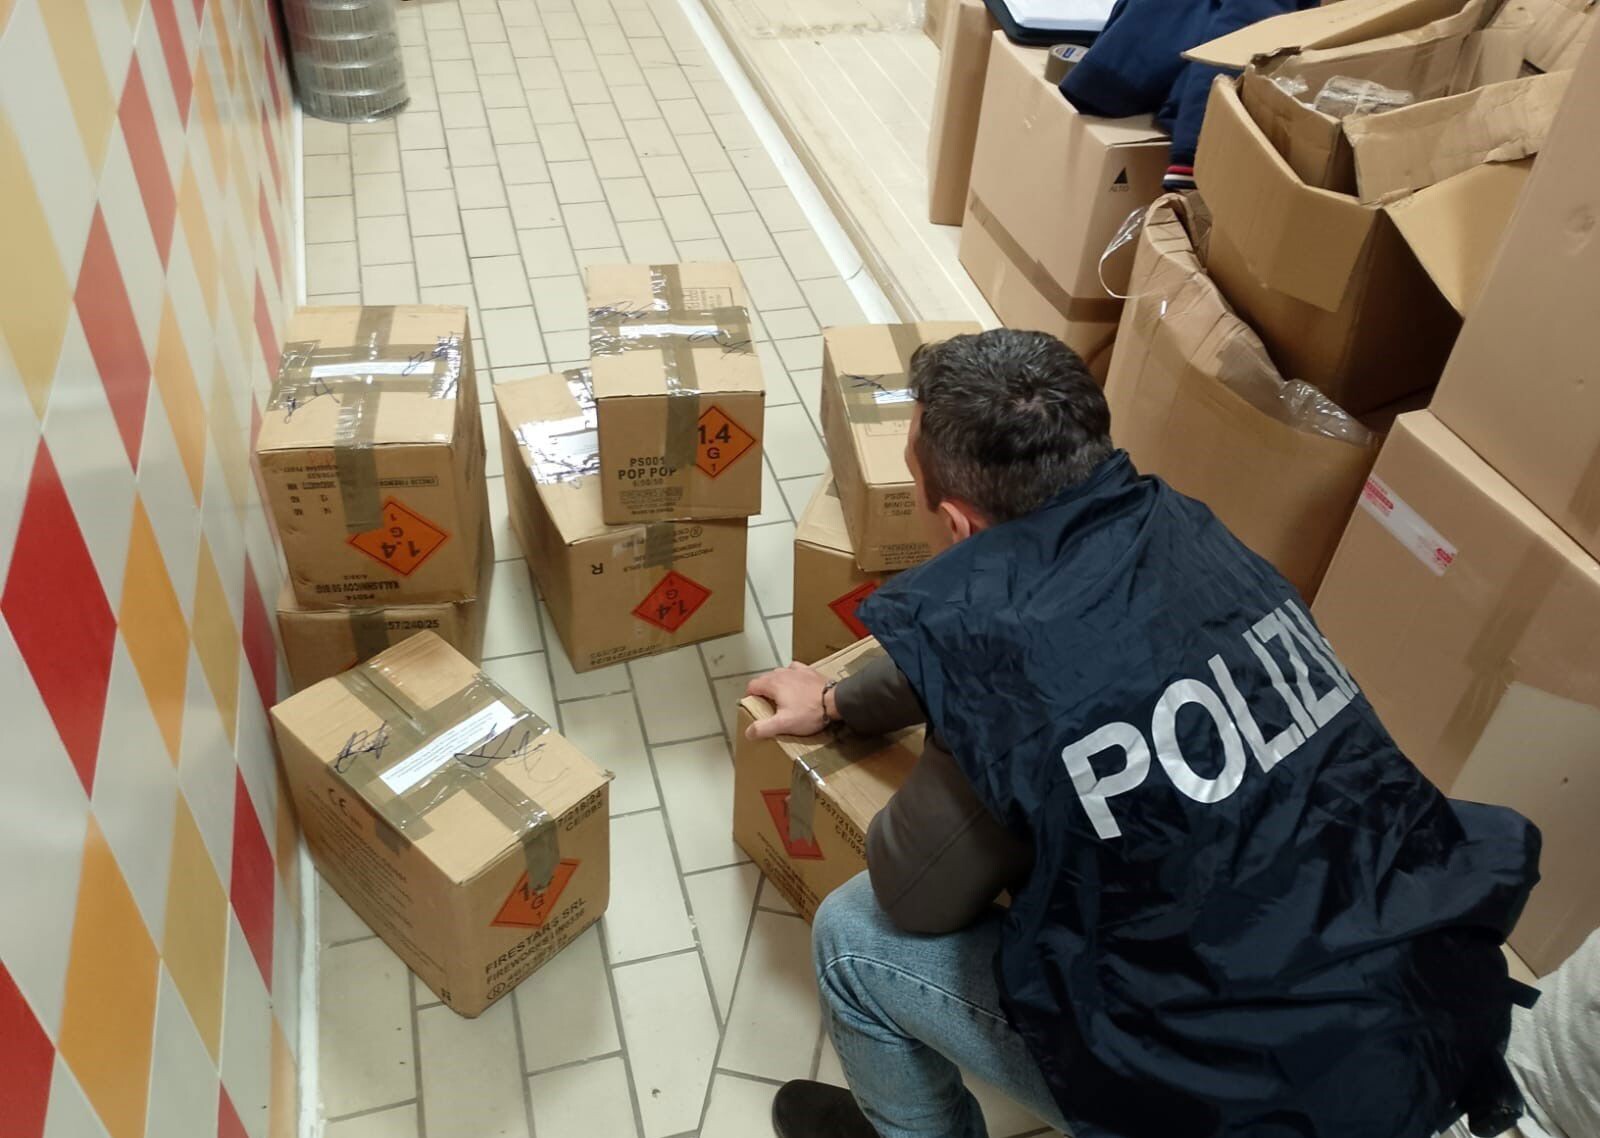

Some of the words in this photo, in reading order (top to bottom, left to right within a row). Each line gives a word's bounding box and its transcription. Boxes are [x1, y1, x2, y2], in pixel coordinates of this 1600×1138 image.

[697, 423, 731, 444] 1.4
[706, 447, 720, 460] G
[617, 468, 646, 480] POP
[649, 466, 678, 479] POP
[711, 464, 717, 473] 1
[389, 526, 404, 538] G
[380, 540, 421, 559] 1.4
[591, 562, 604, 576] R
[665, 588, 678, 599] G
[656, 599, 689, 620] 1.4
[1061, 599, 1360, 839] POLIZI
[531, 893, 545, 910] G
[485, 917, 560, 974] FIRESTARS
[562, 897, 586, 920] SRL
